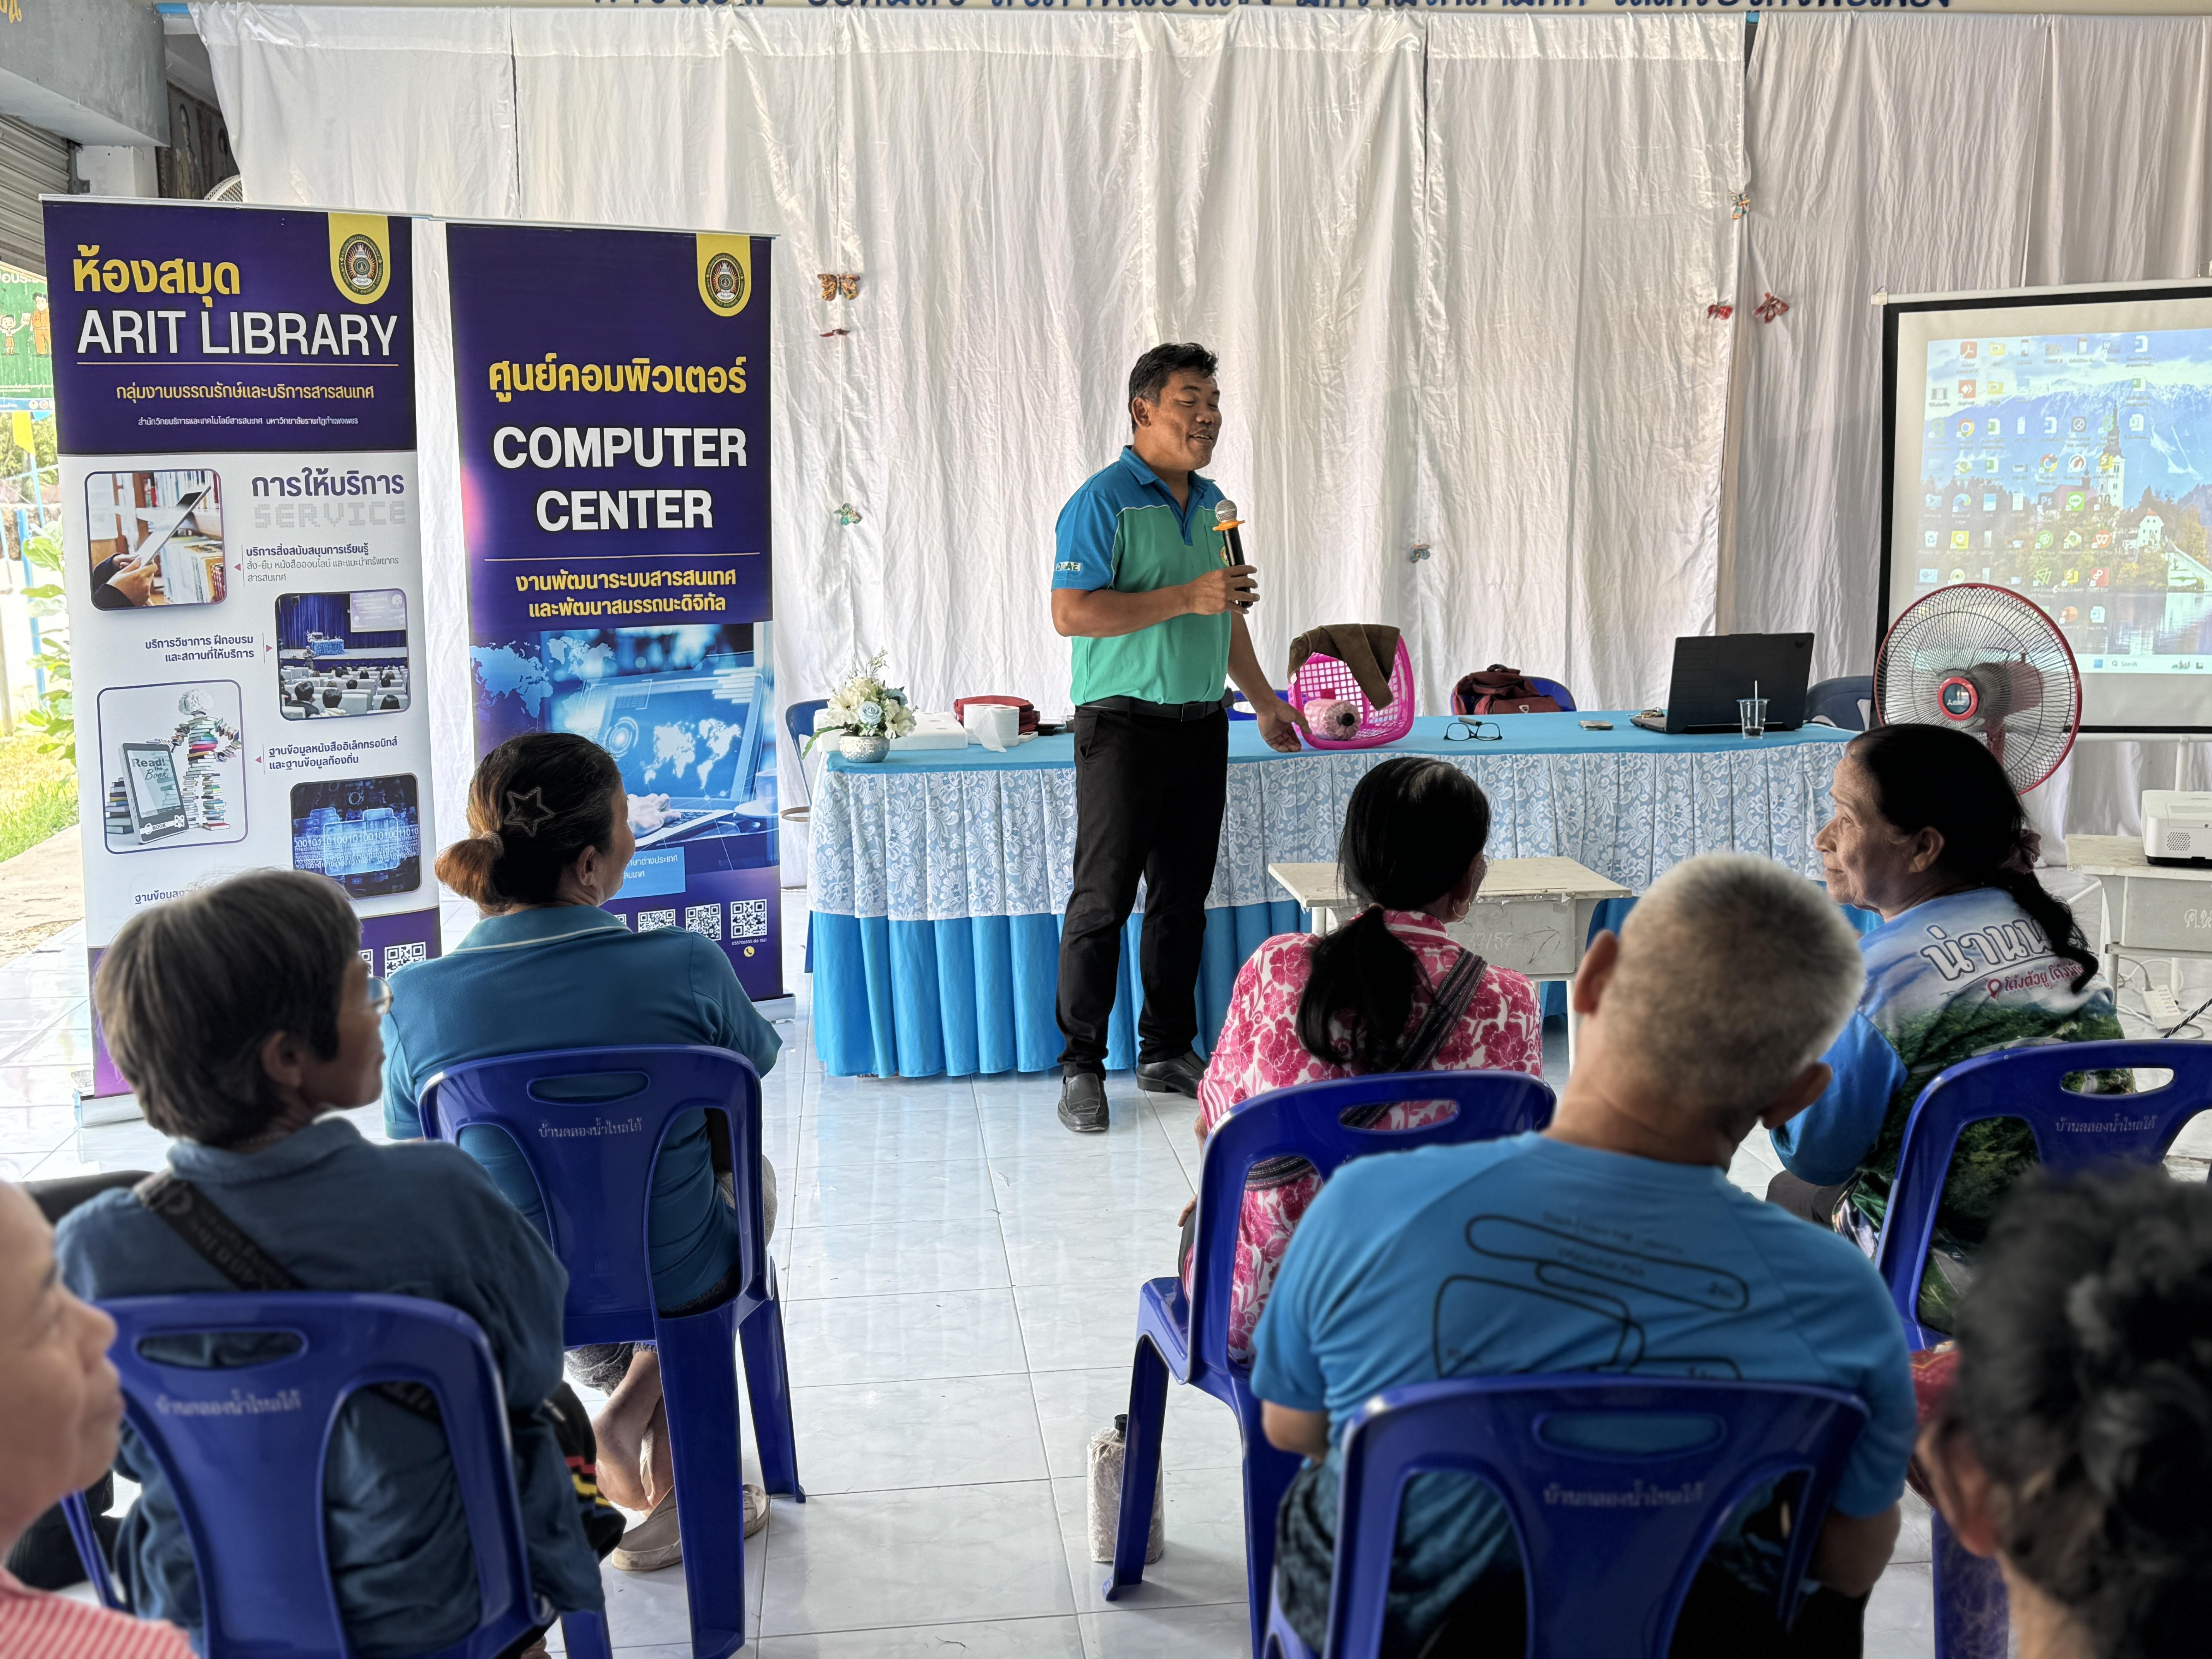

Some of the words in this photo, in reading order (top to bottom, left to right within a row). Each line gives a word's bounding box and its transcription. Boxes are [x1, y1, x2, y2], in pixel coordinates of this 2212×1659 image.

[74, 245, 240, 307] ห้องสมุด
[78, 310, 186, 353] ARIT
[201, 311, 397, 356] LIBRARY
[489, 353, 746, 402] ศูนย์คอมพิวเตอร์
[117, 381, 374, 404] กลุ่มงานบรรณรักษ์และบริการสารสนเทศ
[494, 427, 747, 468] COMPUTER
[252, 467, 404, 497] การให้บริการ
[254, 500, 406, 528] SERVICE
[536, 489, 713, 532] CENTER
[246, 543, 369, 558] บริการสิ่งสนับสนุนการเรียนรู้
[275, 557, 331, 569] หนังสือออนไลน์
[333, 557, 399, 567] และแนะนำทรัพยากร
[248, 573, 287, 582] สารสนเทศ
[515, 569, 736, 592] งานพัฒนาระบบสารสนเทศ
[529, 592, 726, 617] และพัฒนาสมรรถนะดิจิทัล
[145, 637, 211, 649] บริการวิชาการ
[214, 634, 253, 645] ฝึกอบรม
[165, 647, 254, 662] และสถานที่ให้บริการ
[269, 736, 397, 757] ฐานข้อมูลหนังสืออิเล็กทรอนิกส์
[269, 752, 359, 770] และฐานข้อมูลท้องถิ่น
[630, 854, 678, 866] าษาต่างประเทศ
[623, 870, 645, 879] สนเทศ
